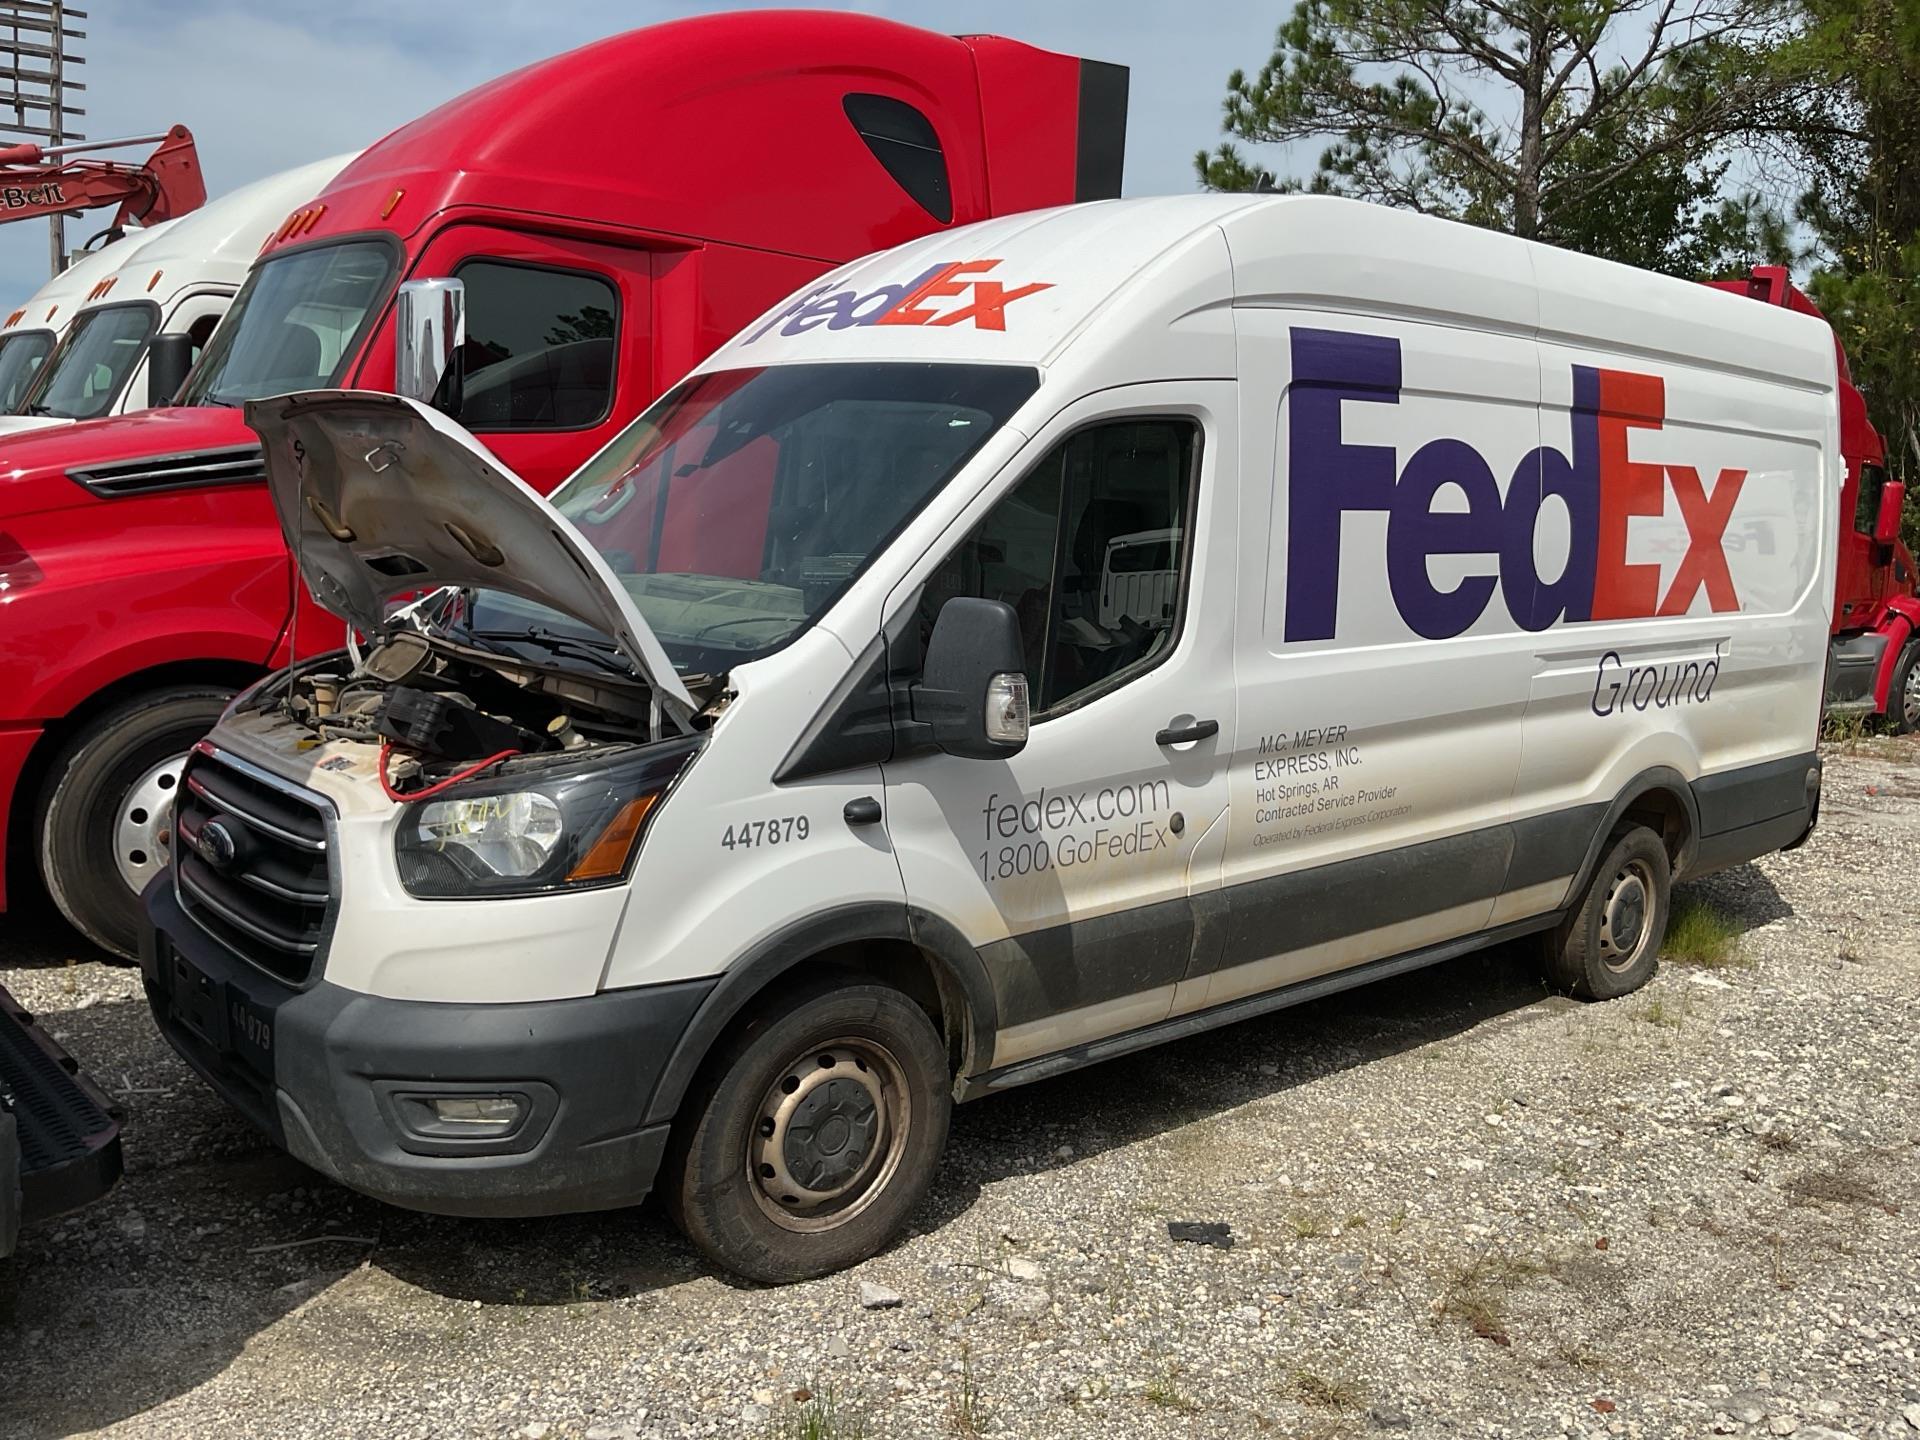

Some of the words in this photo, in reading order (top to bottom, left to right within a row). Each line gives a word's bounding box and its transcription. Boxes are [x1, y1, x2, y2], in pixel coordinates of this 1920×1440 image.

[740, 259, 1057, 347] FedEx
[1284, 326, 1748, 643] FedEx
[1591, 643, 1721, 717] Ground
[1258, 733, 1288, 755] M.C.
[1292, 725, 1348, 749] MEYER
[1254, 751, 1332, 781] EXPRESS,
[1335, 747, 1363, 767] INC.
[982, 779, 1171, 841] fedex.com
[1255, 799, 1314, 824] Contracted
[1317, 793, 1355, 811] Service
[1357, 785, 1397, 803] Provider
[1256, 787, 1275, 803] Hot
[1278, 781, 1320, 801] Springs,
[1322, 775, 1339, 792] AR
[721, 815, 810, 851] 447879
[1253, 828, 1292, 847] Operated
[1304, 820, 1335, 836] Federal
[1335, 815, 1367, 830] Express
[1367, 804, 1413, 823] Corporation
[979, 820, 1168, 882] 1.800.GoFedEx
